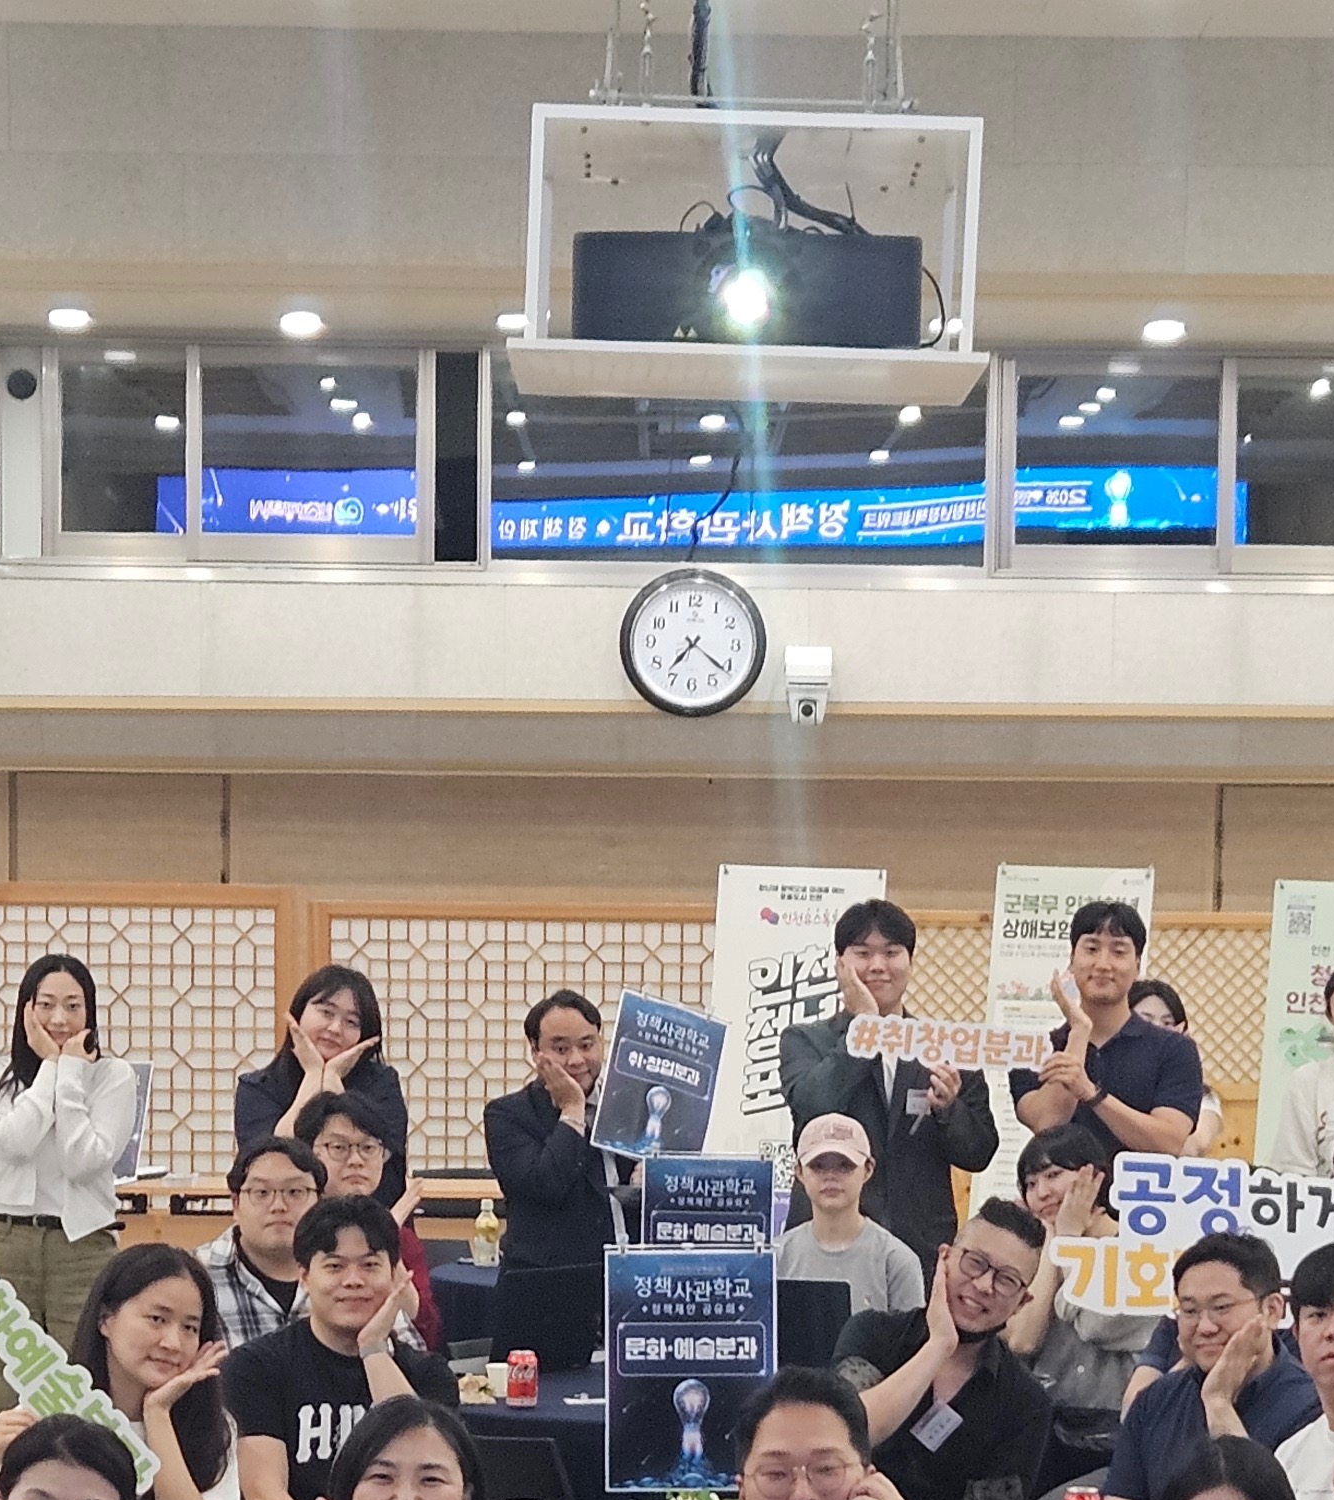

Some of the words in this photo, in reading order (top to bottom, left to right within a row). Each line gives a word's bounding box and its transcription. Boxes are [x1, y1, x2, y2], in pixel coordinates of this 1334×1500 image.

[669, 600, 679, 613] 11
[689, 594, 703, 608] 12
[653, 616, 666, 630] 10
[725, 617, 736, 630] 2
[646, 634, 657, 649] 9
[730, 638, 741, 652] 3
[651, 655, 662, 670] 8
[667, 672, 679, 687] 7
[686, 677, 697, 693] 6
[707, 673, 718, 687] 5
[852, 1019, 1047, 1066] #취창업분과
[665, 1173, 757, 1197] 정책사관학교
[633, 1274, 754, 1303] 정책사관학교
[624, 1336, 758, 1361] 문화·예술분과
